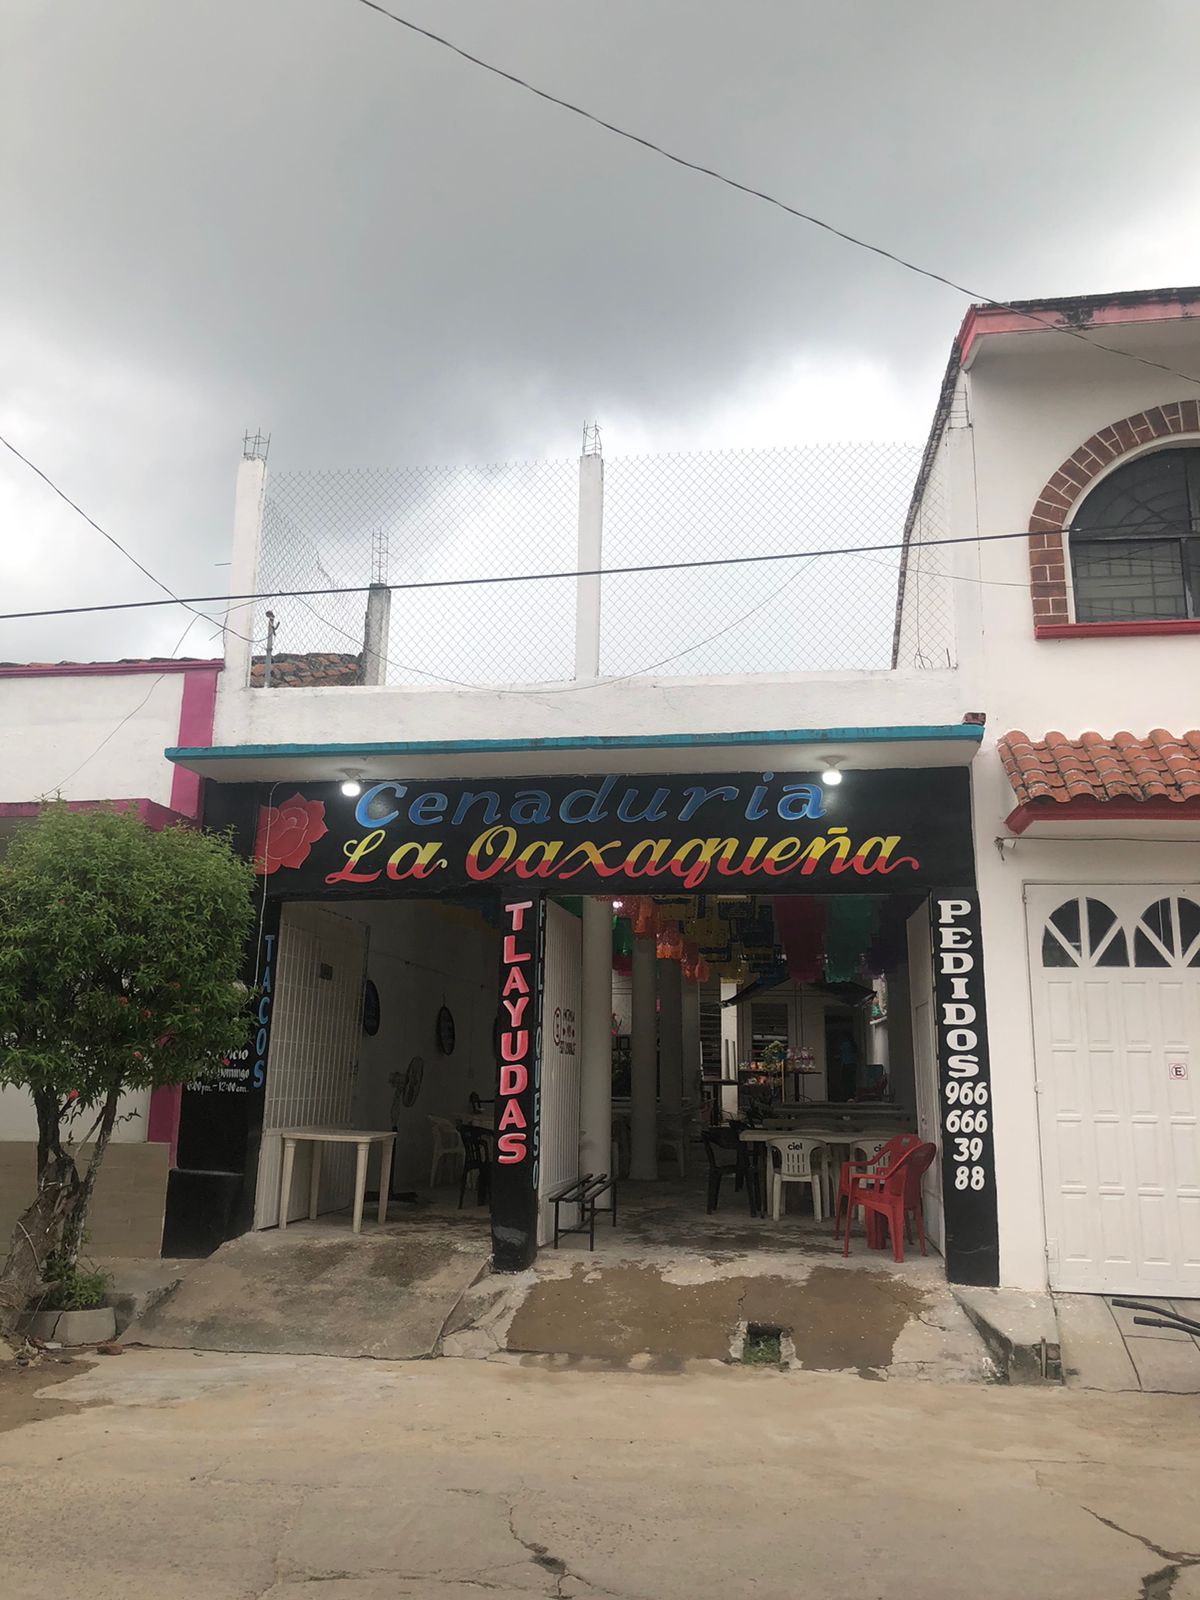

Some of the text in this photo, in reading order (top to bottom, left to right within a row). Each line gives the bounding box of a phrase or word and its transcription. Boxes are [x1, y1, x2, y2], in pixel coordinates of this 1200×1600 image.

[355, 772, 827, 828] Cenaduria
[324, 825, 920, 888] La Oaxaqueña
[937, 900, 979, 1078] PEDIDOS
[253, 934, 275, 1089] TACOS
[497, 900, 533, 1165] TLAYUDAS
[945, 1081, 988, 1105] 966
[946, 1109, 988, 1133] 666
[787, 1141, 803, 1151] ciel
[953, 1137, 983, 1162] 39
[955, 1165, 985, 1191] 88
